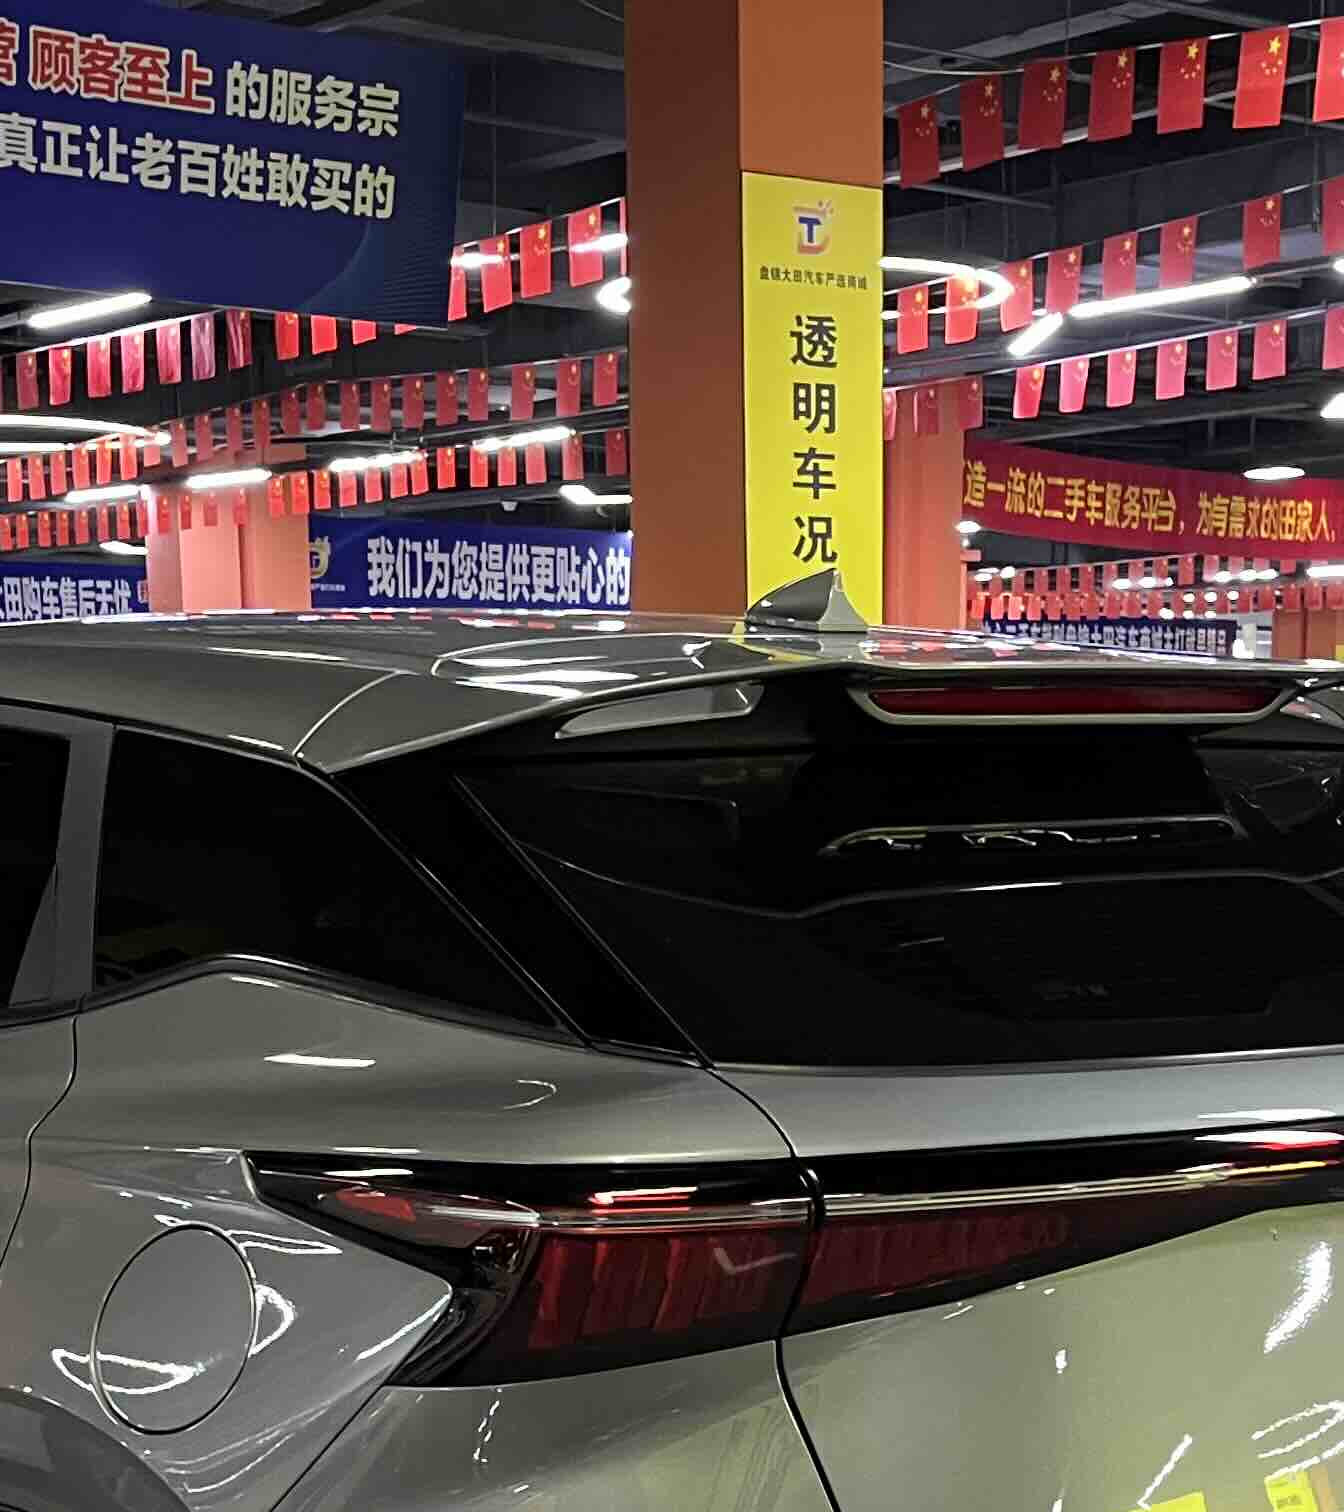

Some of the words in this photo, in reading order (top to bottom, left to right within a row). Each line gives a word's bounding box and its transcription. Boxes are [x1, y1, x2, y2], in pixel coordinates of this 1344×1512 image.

[29, 24, 216, 114] 顾客至上
[226, 61, 399, 138] 的服务宗
[790, 314, 838, 563] 透明车况
[367, 536, 632, 606] 我们为您提供更贴心的
